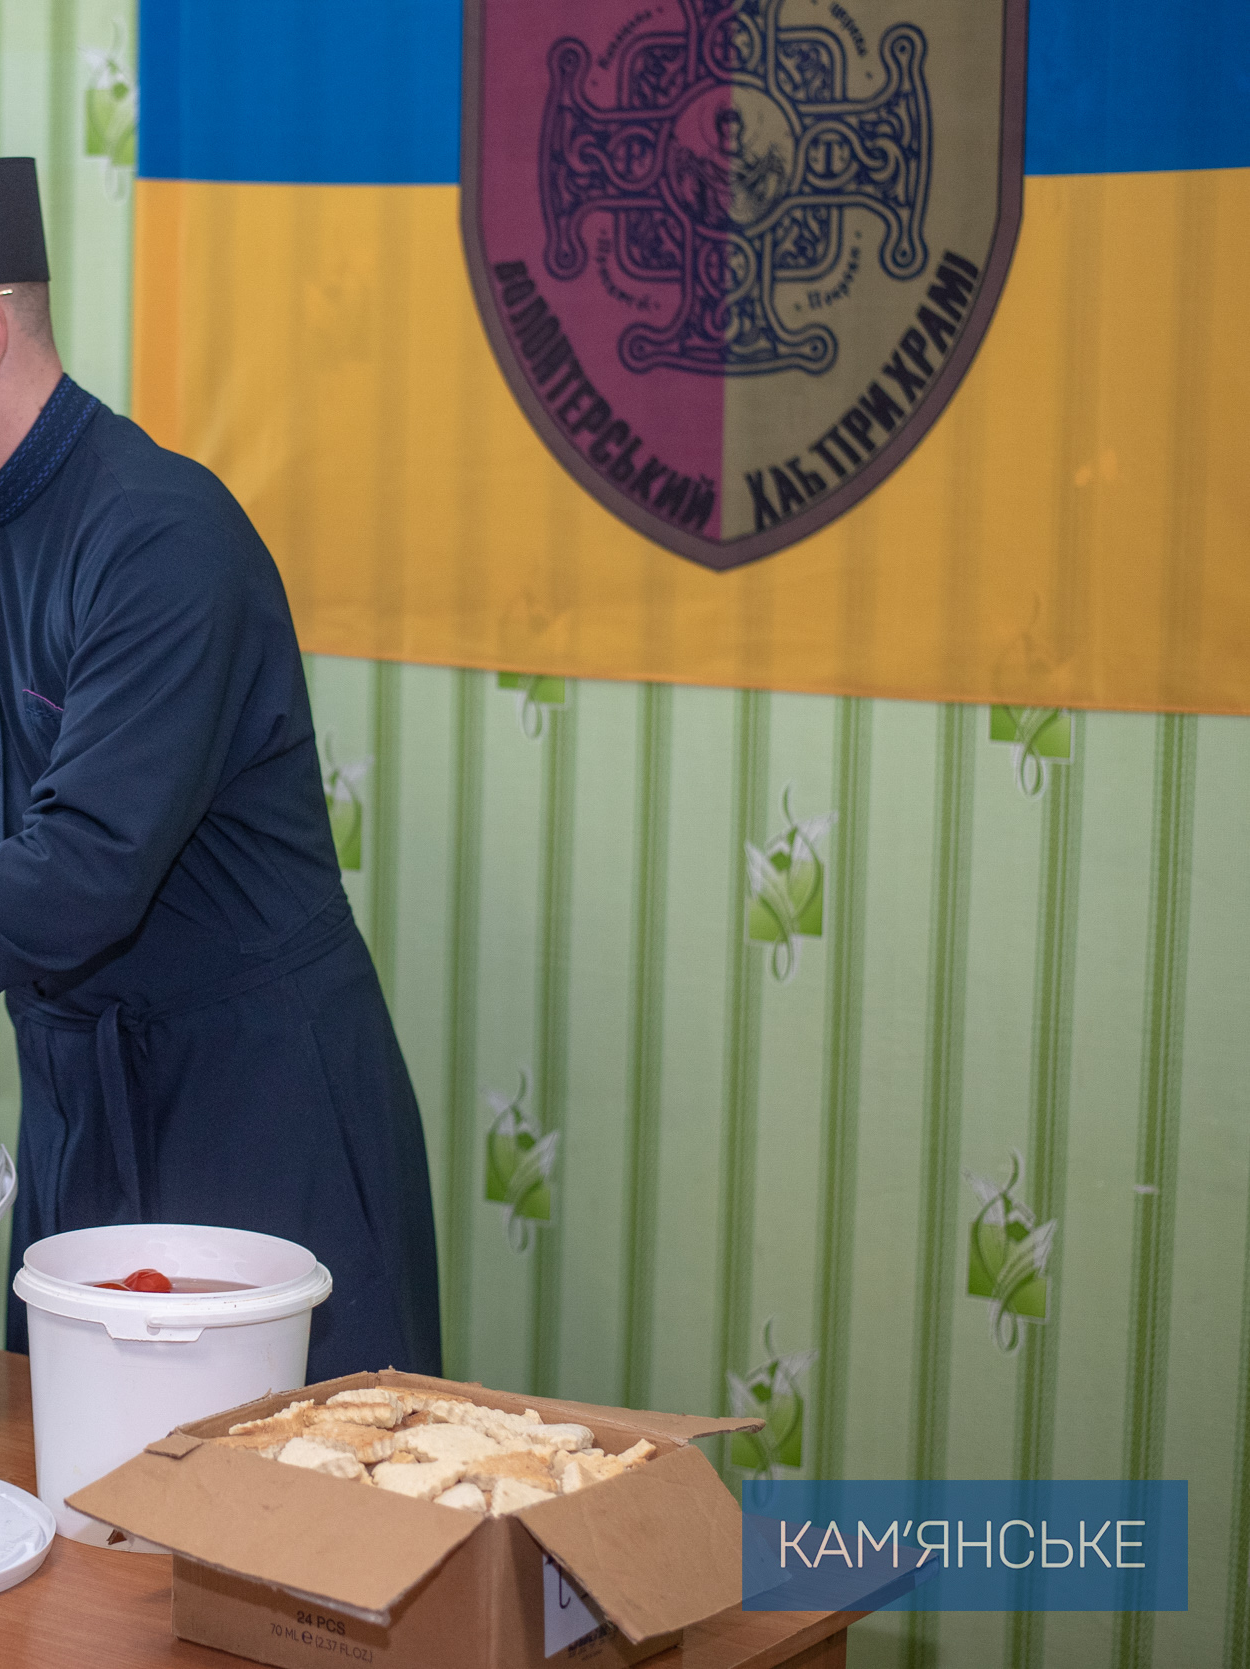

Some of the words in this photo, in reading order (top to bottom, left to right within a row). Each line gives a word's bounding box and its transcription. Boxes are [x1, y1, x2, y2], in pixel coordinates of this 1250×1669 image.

[744, 456, 827, 532] ХАБ
[807, 381, 906, 479] ПРИ
[882, 251, 979, 404] ХРАМІ
[271, 1623, 283, 1636] 70
[285, 1627, 299, 1642] ML
[296, 1610, 313, 1625] 24
[317, 1615, 346, 1636] PCS
